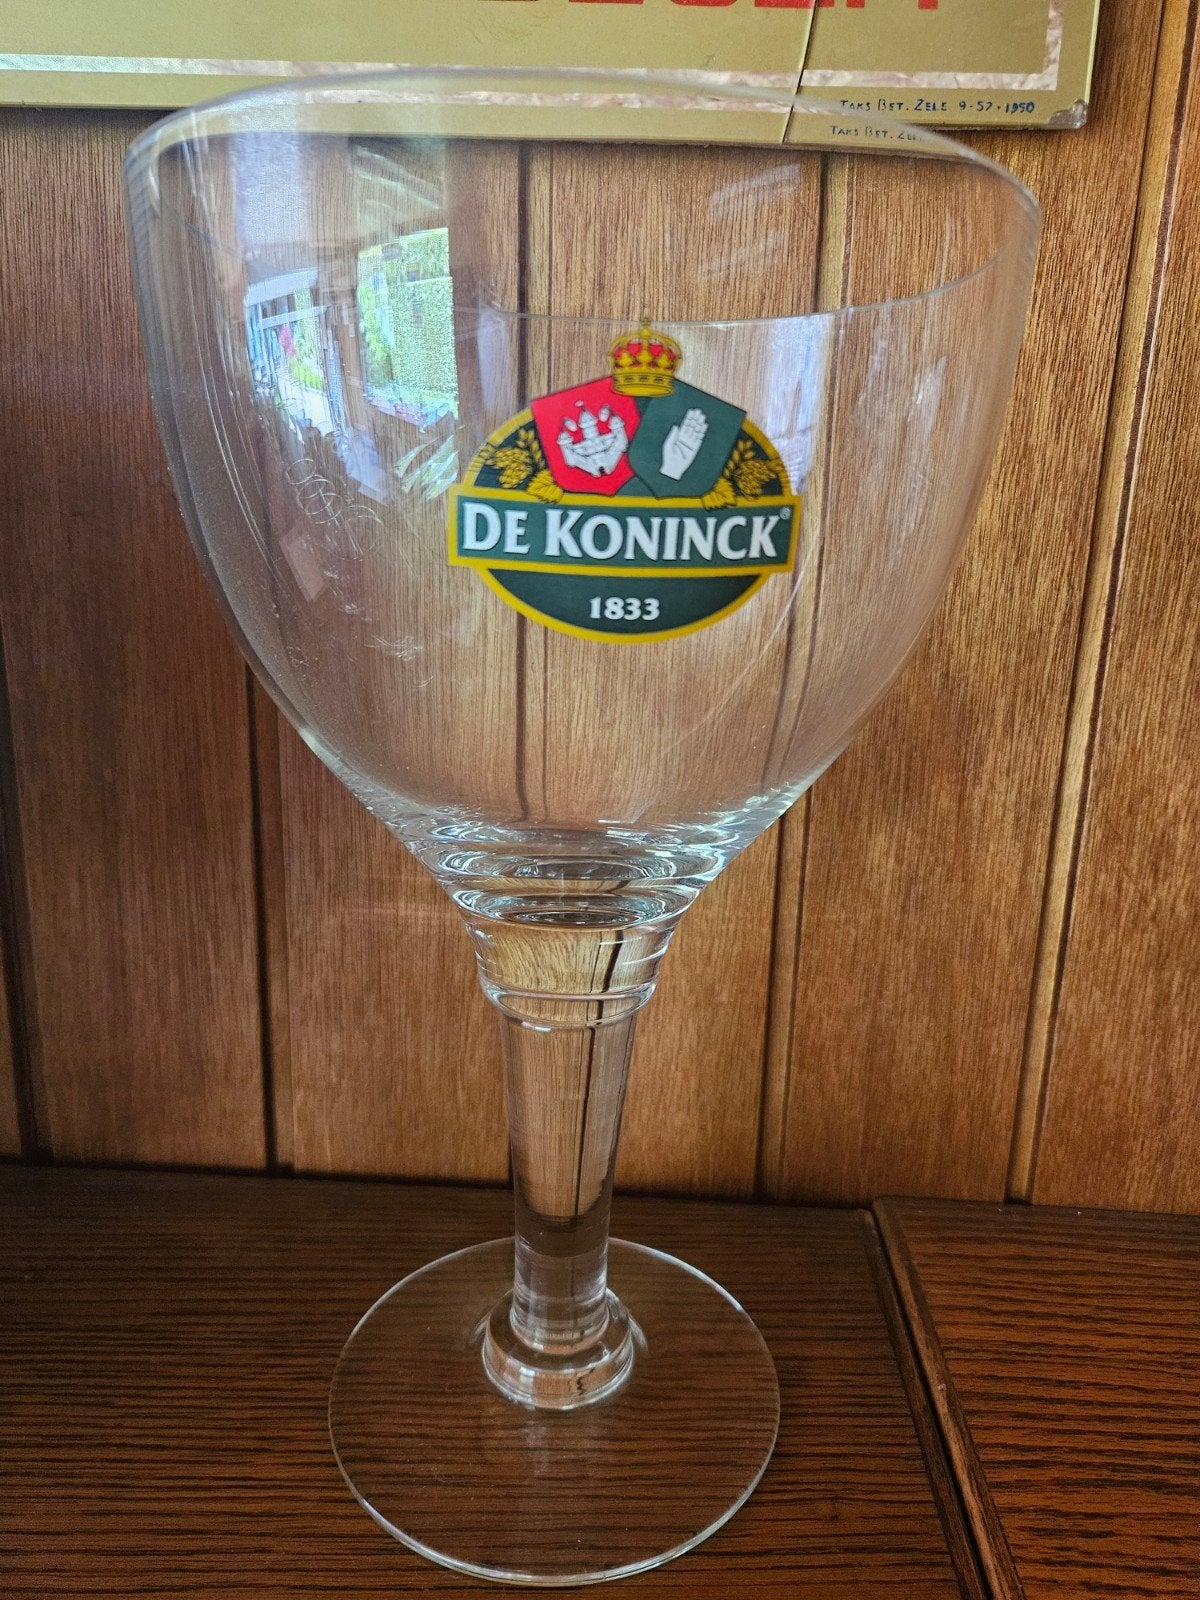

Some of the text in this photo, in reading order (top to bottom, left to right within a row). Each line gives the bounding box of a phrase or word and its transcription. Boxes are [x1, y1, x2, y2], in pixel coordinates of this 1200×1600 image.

[840, 99, 871, 112] TAKS
[913, 98, 948, 112] ZELE
[462, 501, 779, 561] DE KONINCK
[589, 596, 660, 621] 1833
